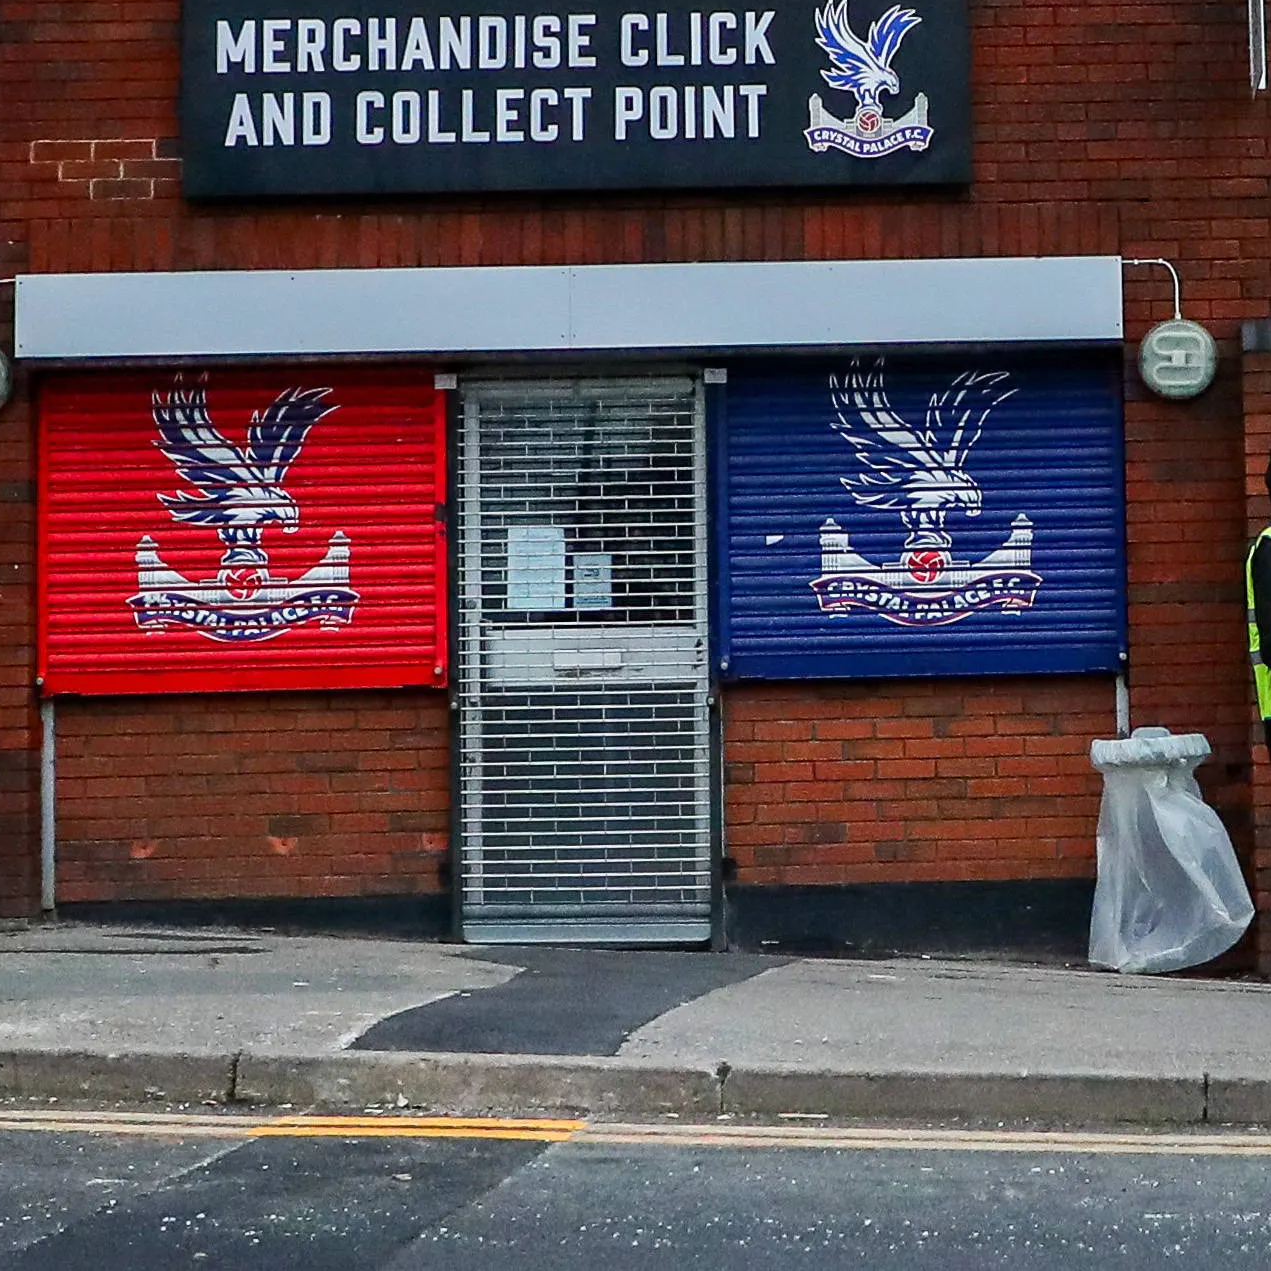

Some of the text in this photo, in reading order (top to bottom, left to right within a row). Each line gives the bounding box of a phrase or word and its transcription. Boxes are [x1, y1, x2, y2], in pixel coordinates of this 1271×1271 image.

[216, 11, 776, 73] MERCHANDISE CLICK
[225, 84, 767, 147] AND COLLECT POINT
[814, 129, 924, 153] CRYSTAL PALACE F.C.
[231, 600, 306, 636] PALACE
[827, 581, 909, 618] CRYSTAL
[915, 584, 991, 619] PALACE
